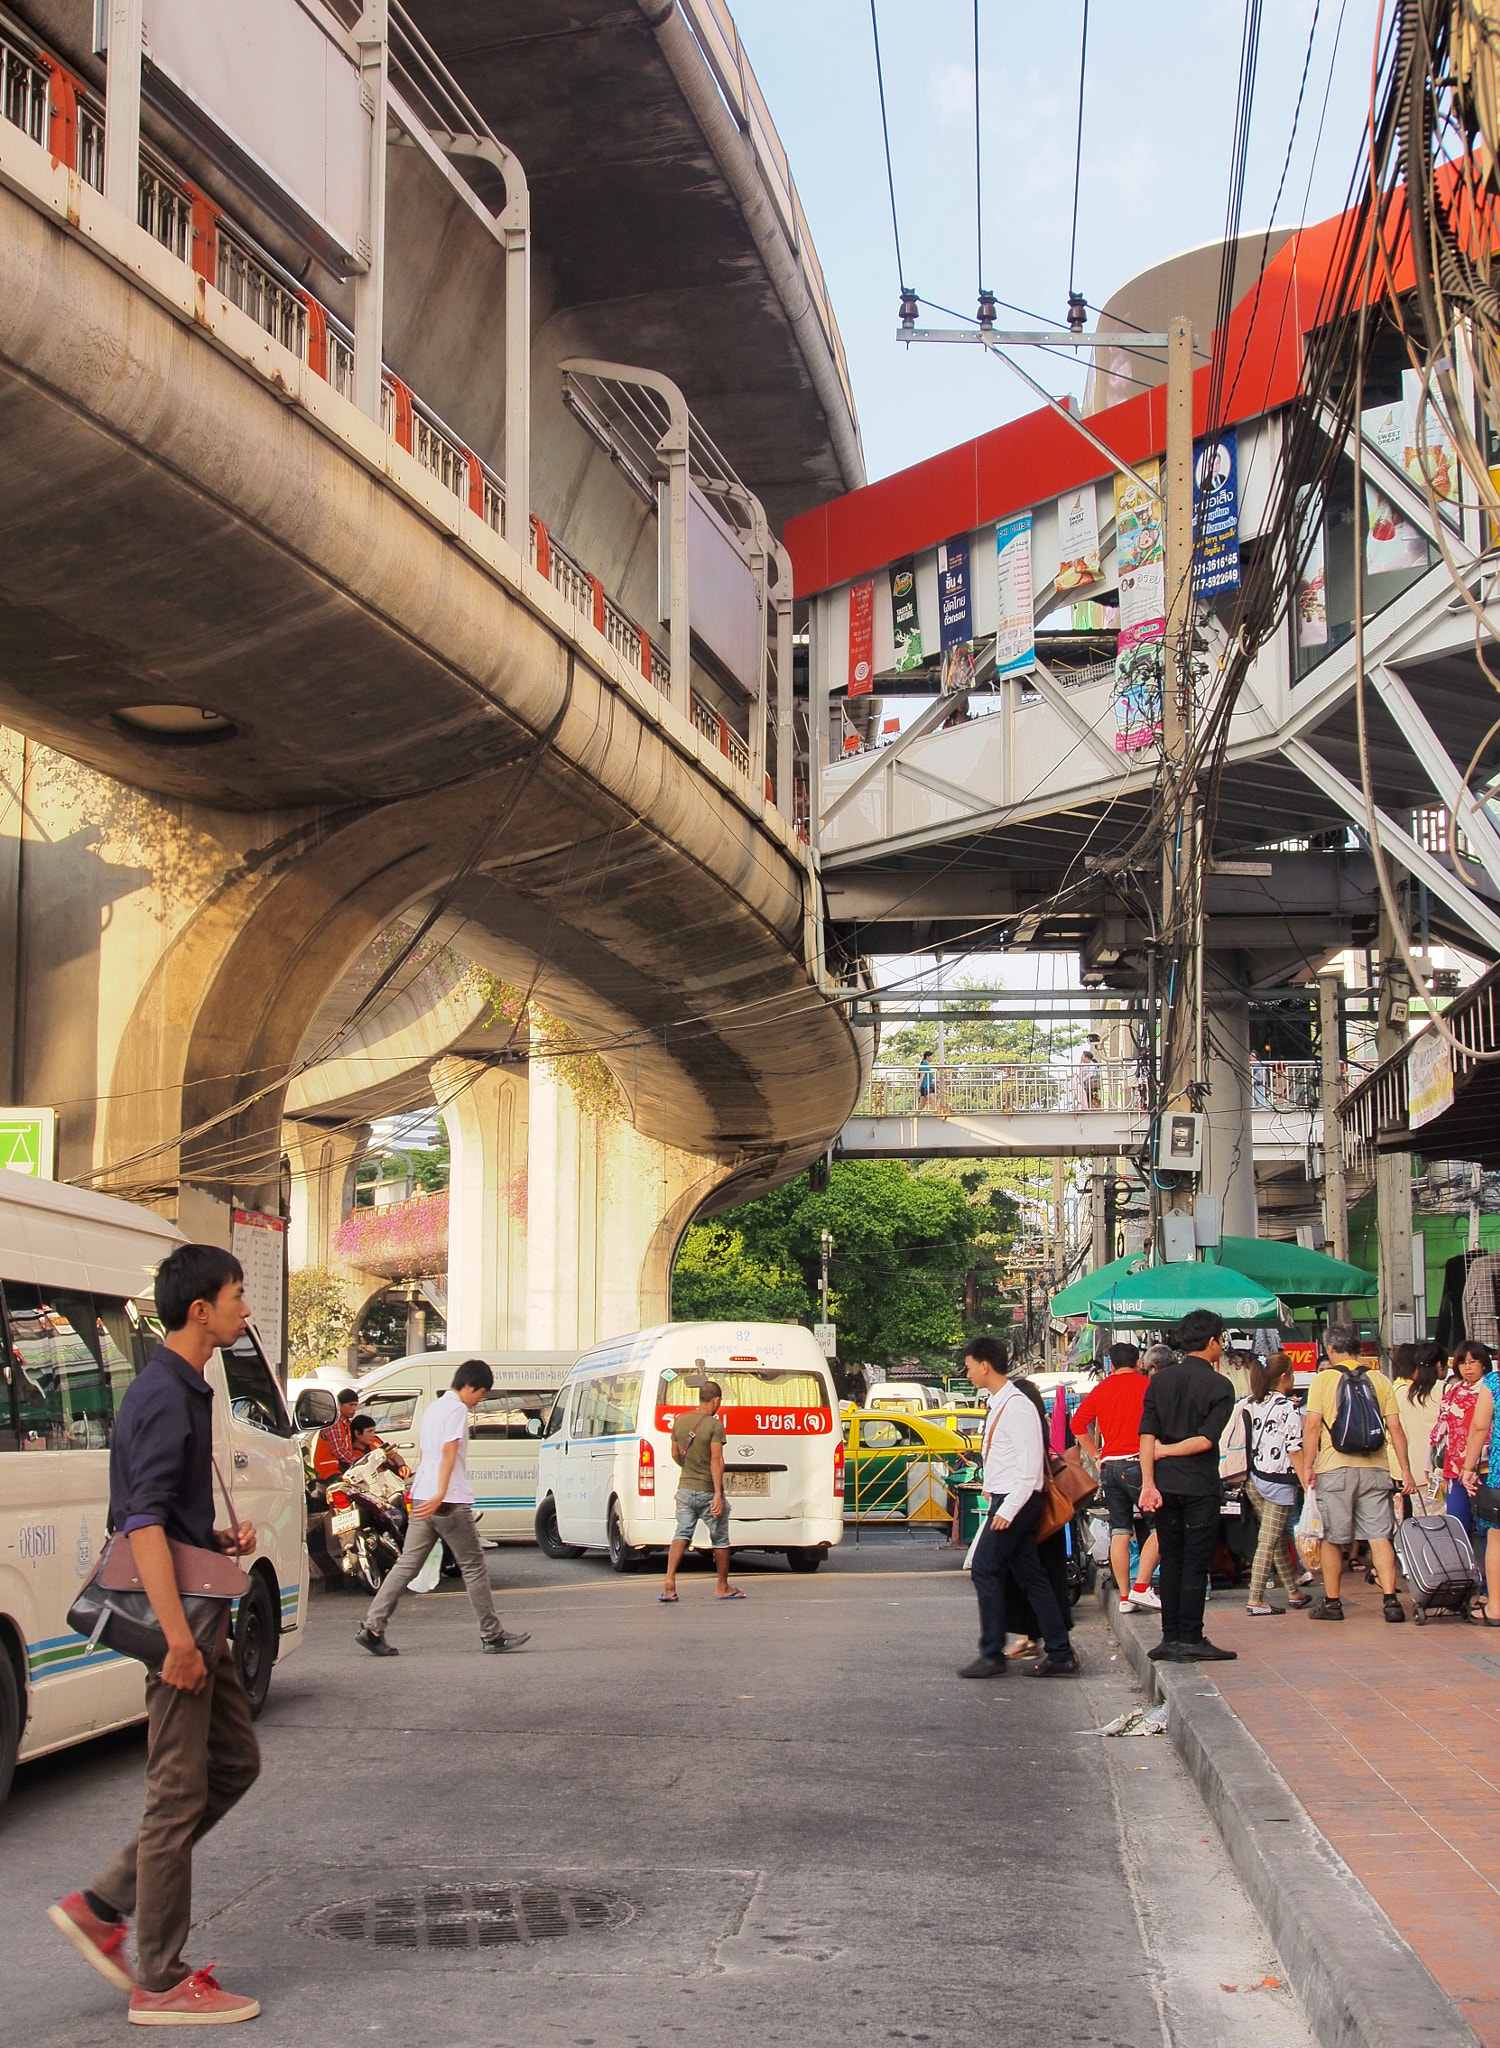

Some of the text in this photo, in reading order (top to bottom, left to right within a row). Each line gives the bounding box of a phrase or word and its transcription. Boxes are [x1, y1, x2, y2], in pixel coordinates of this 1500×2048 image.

[1376, 430, 1401, 440] SWEET
[1377, 436, 1401, 446] DREAM
[957, 573, 963, 585] 4
[735, 1330, 751, 1342] 82
[1284, 1350, 1313, 1364] FIVE
[755, 1412, 826, 1432] บขส.(จ)
